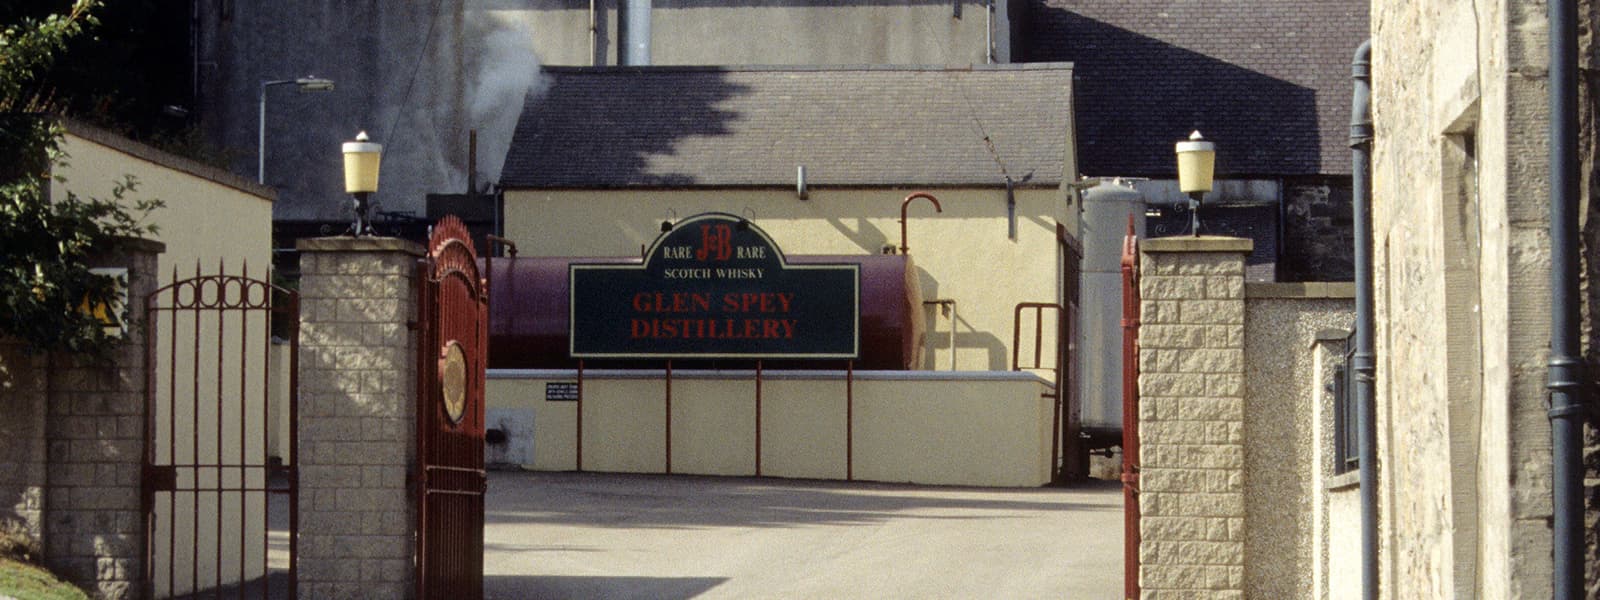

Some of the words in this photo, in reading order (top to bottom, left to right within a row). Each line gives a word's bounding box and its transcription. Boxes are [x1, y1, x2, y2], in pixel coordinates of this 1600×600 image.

[663, 246, 693, 259] RARE
[696, 223, 732, 262] J&B
[737, 246, 767, 259] RARE
[664, 268, 711, 279] SCOTCH
[716, 268, 765, 279] WHISKY
[632, 292, 711, 313] GLEN
[722, 292, 795, 313] SPEY
[631, 319, 798, 339] DISTILLERY
